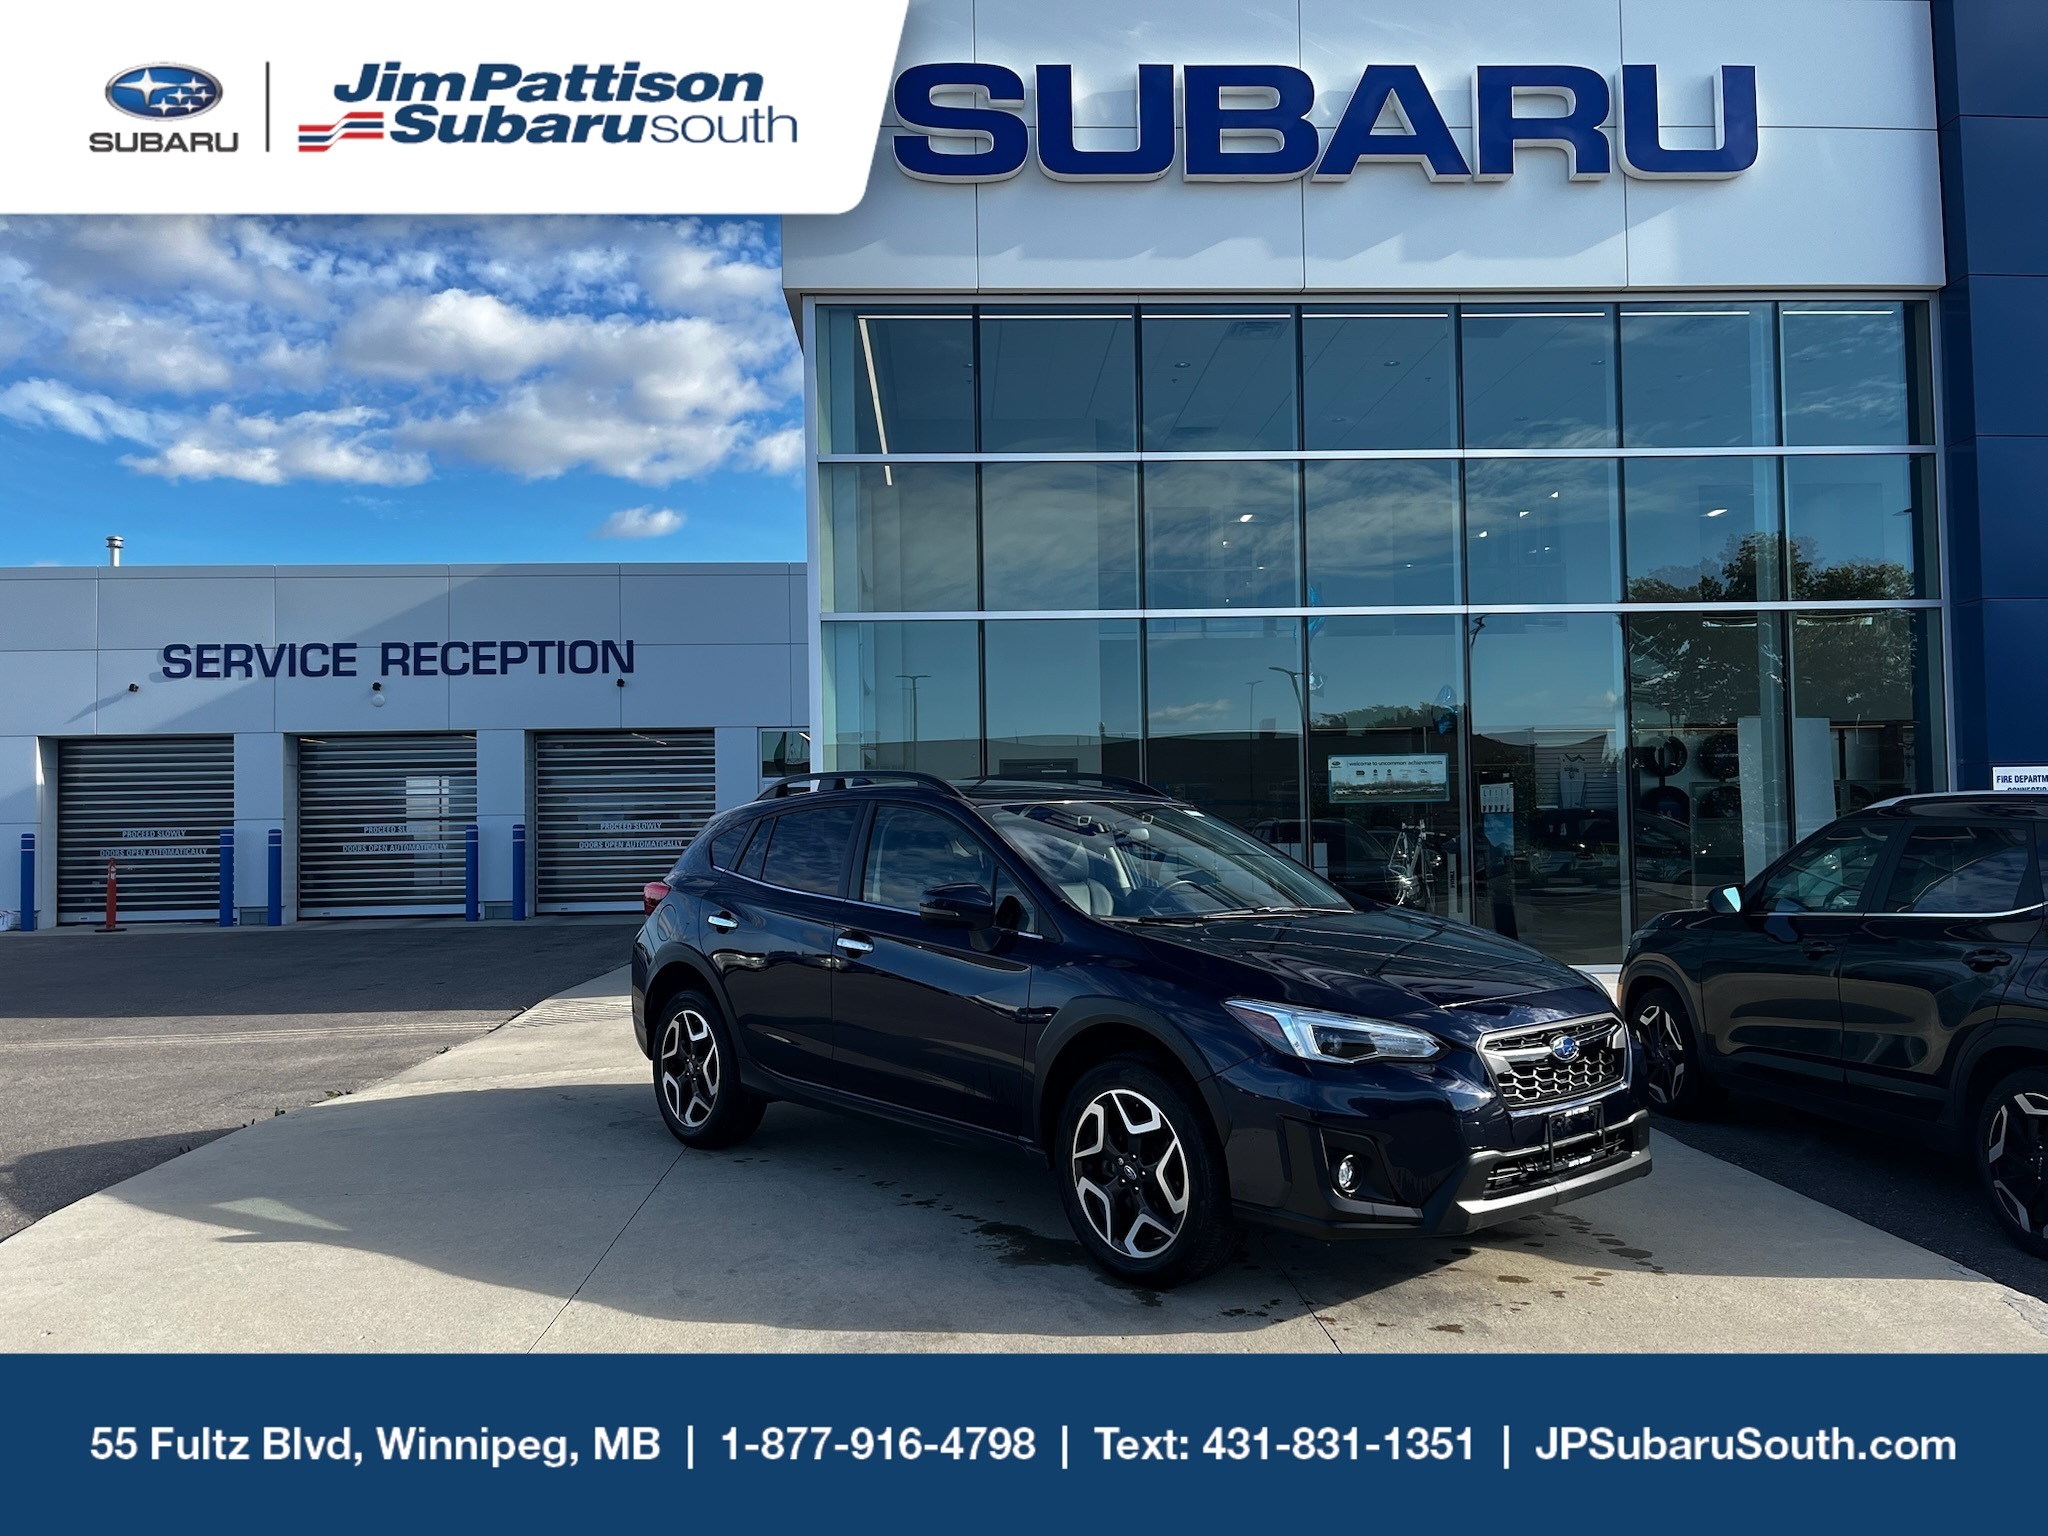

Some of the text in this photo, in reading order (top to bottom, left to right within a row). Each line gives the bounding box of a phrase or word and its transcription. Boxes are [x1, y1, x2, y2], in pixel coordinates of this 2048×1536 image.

[893, 63, 1757, 182] SUBARU
[162, 639, 635, 679] SERVICE RECEPTION
[1996, 775, 2013, 784] FIRE
[363, 826, 396, 834] PROCEED
[600, 822, 662, 831] PROCEED SLOWLY
[122, 829, 187, 838] PROCEED SLOWLY
[342, 843, 448, 853] DOORS OPEN AUTOMATICALLY
[578, 840, 683, 849] DOORS OPEN AUTOMATICALLY
[100, 847, 208, 857] DOORS OPEN AUTOMATICALLY
